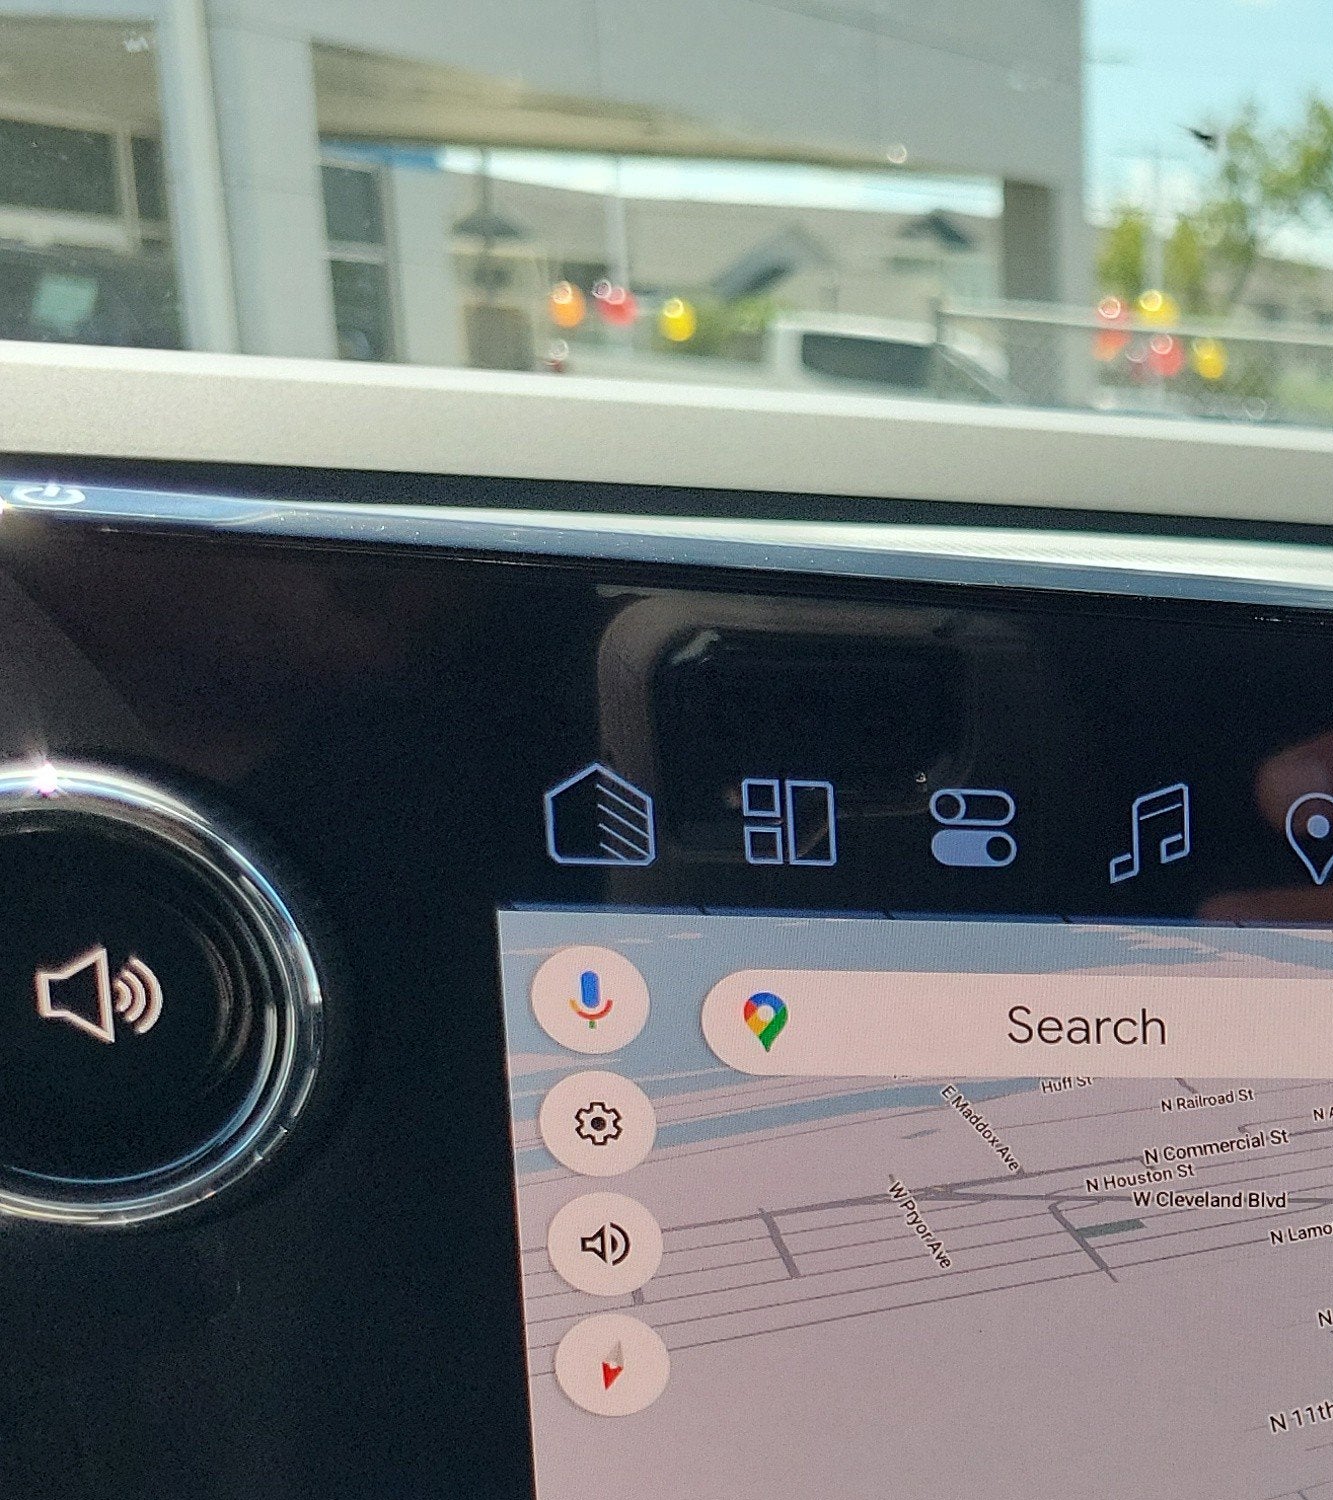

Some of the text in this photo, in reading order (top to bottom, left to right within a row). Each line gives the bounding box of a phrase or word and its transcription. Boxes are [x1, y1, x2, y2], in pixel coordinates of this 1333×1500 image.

[1008, 1005, 1166, 1046] Search
[1162, 1088, 1254, 1112] N Railroad St
[942, 1085, 1018, 1171] E Maddox Ave
[1145, 1129, 1288, 1164] N Commercial St
[1133, 1191, 1286, 1208] W Cleveland Blvd
[888, 1179, 950, 1268] W Pryor Ave
[1270, 1230, 1284, 1244] N
[1318, 1311, 1333, 1327] N
[1270, 1414, 1286, 1432] N
